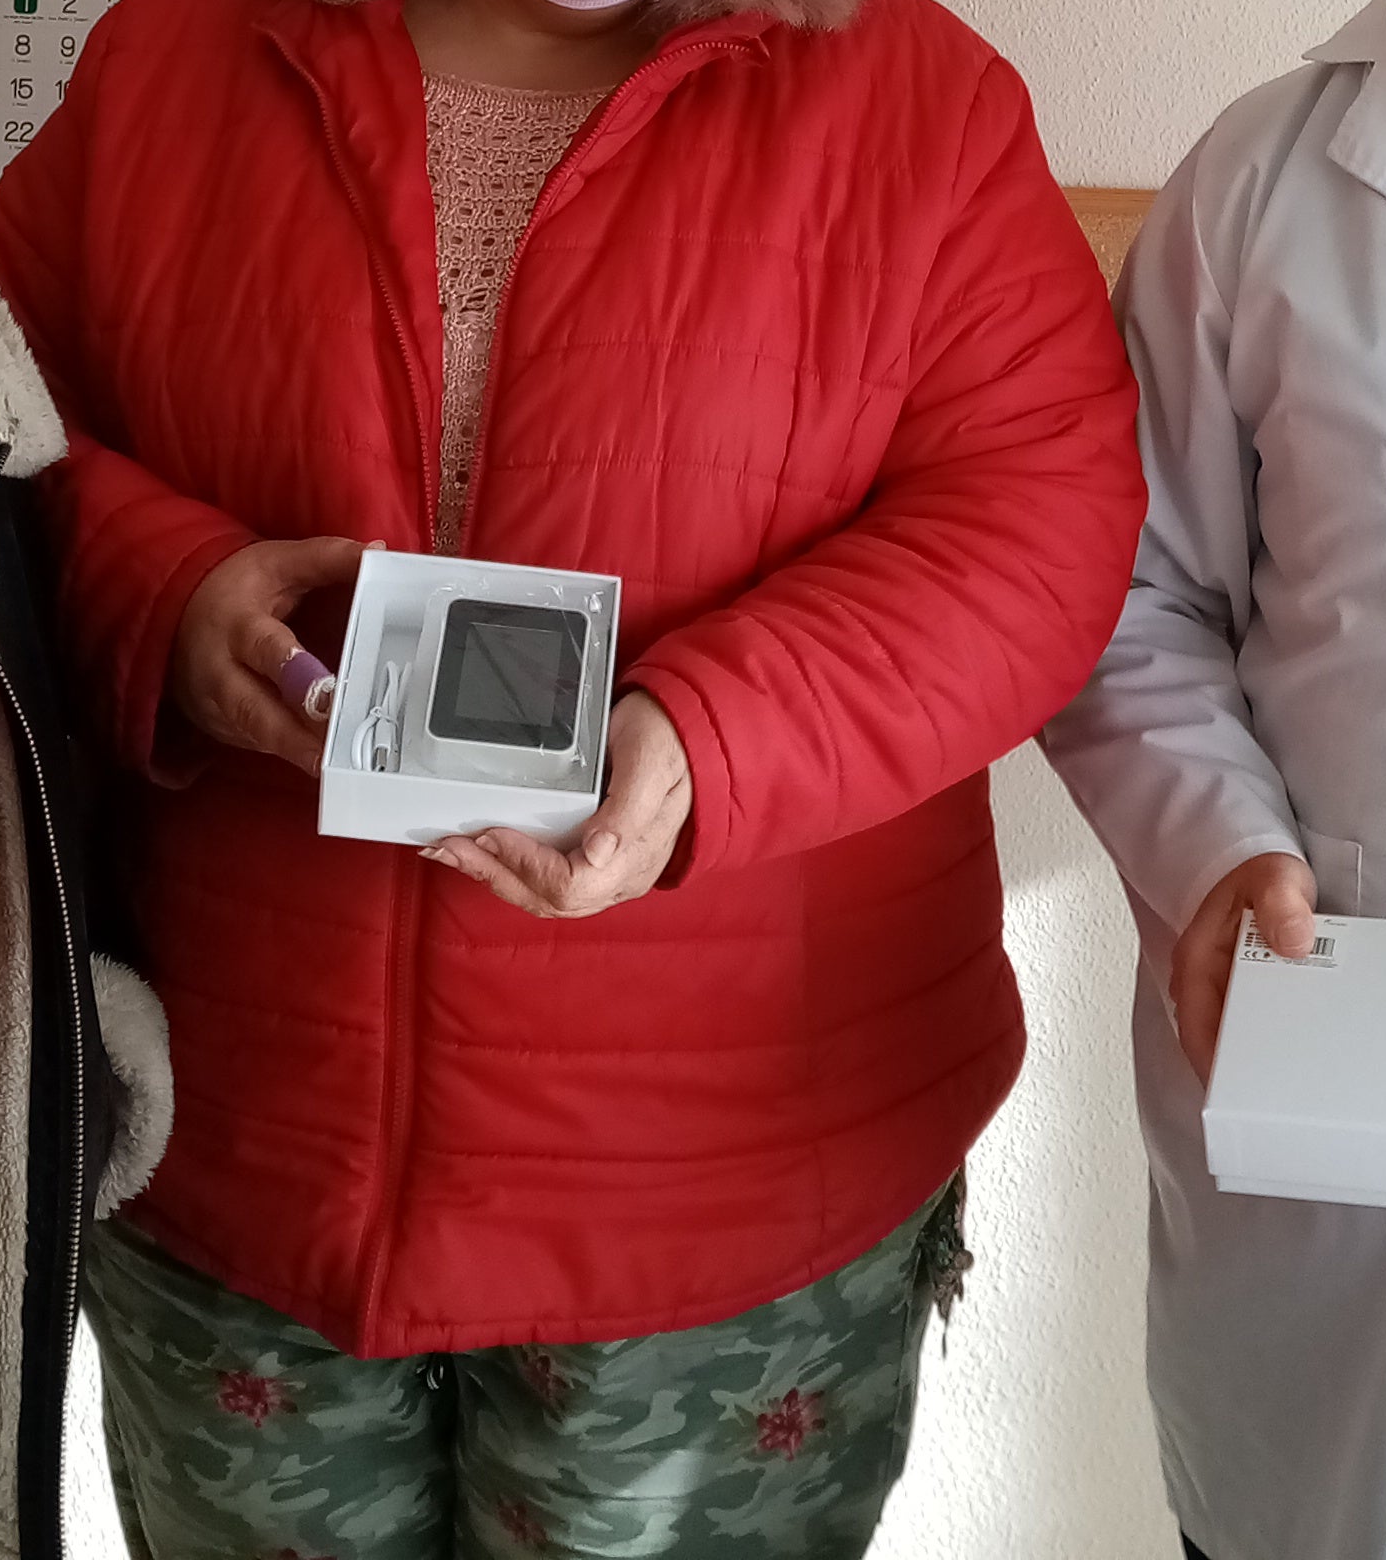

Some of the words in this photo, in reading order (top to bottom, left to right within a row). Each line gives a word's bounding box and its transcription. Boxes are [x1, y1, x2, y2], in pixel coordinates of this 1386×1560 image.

[15, 34, 31, 56] 8
[60, 36, 76, 58] 9
[10, 78, 34, 99] 15
[4, 121, 34, 143] 22
